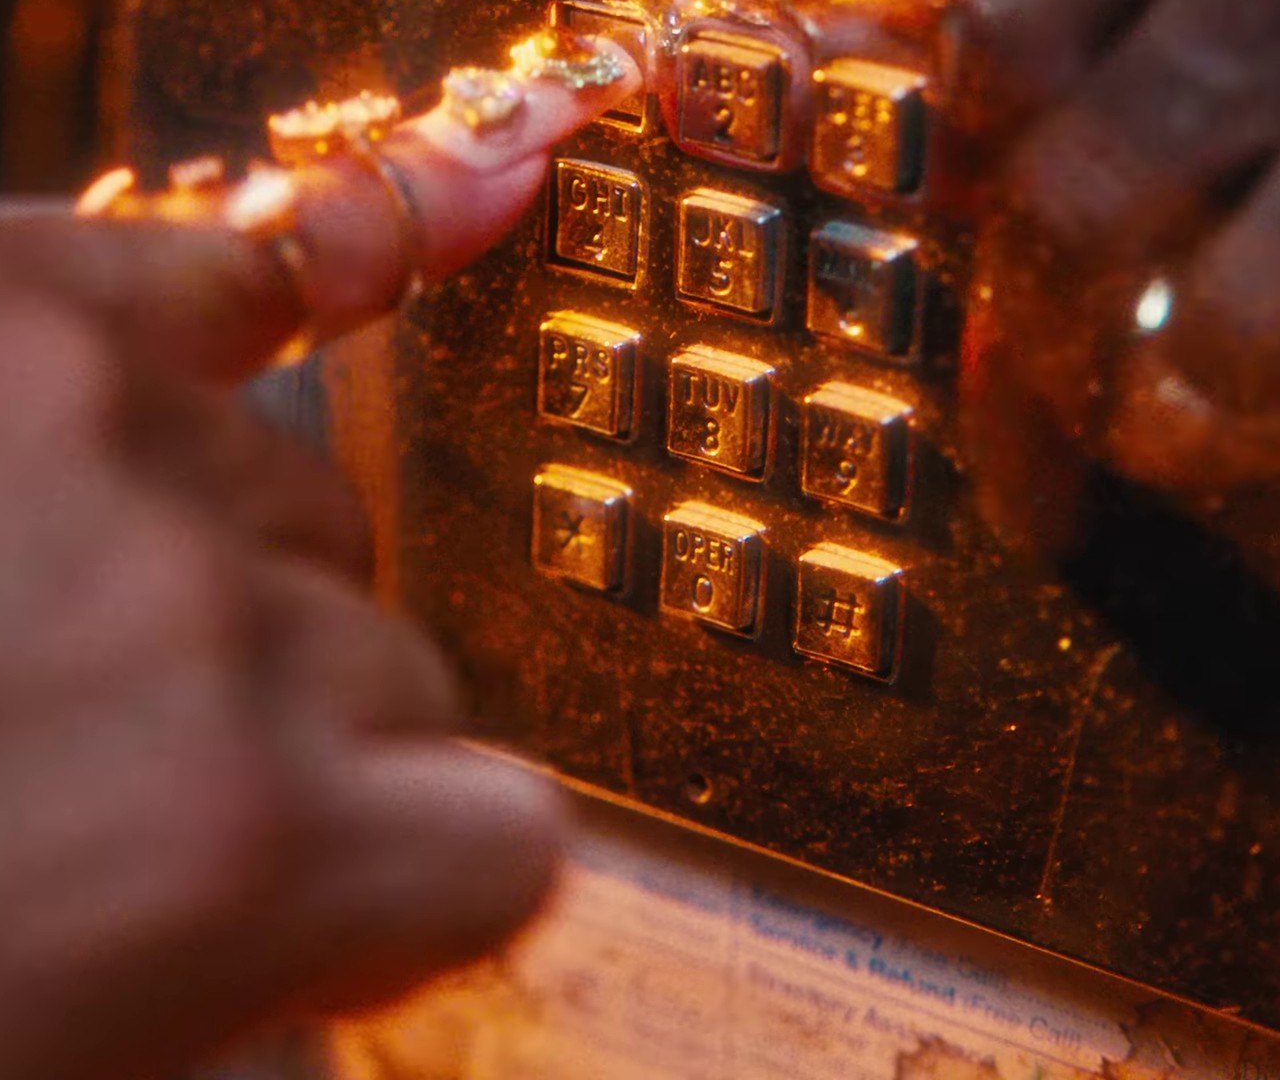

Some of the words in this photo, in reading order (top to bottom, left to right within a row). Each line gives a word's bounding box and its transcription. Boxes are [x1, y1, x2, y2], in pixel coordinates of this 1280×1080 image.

[570, 172, 629, 223] GHI
[689, 212, 755, 258] JKL
[708, 257, 734, 297] 5
[546, 333, 612, 385] PRS
[570, 380, 595, 419] 7
[679, 367, 743, 418] TUV
[700, 416, 722, 457] 8
[834, 456, 859, 497] 9
[673, 527, 736, 576] OPER
[691, 572, 715, 614] 0
